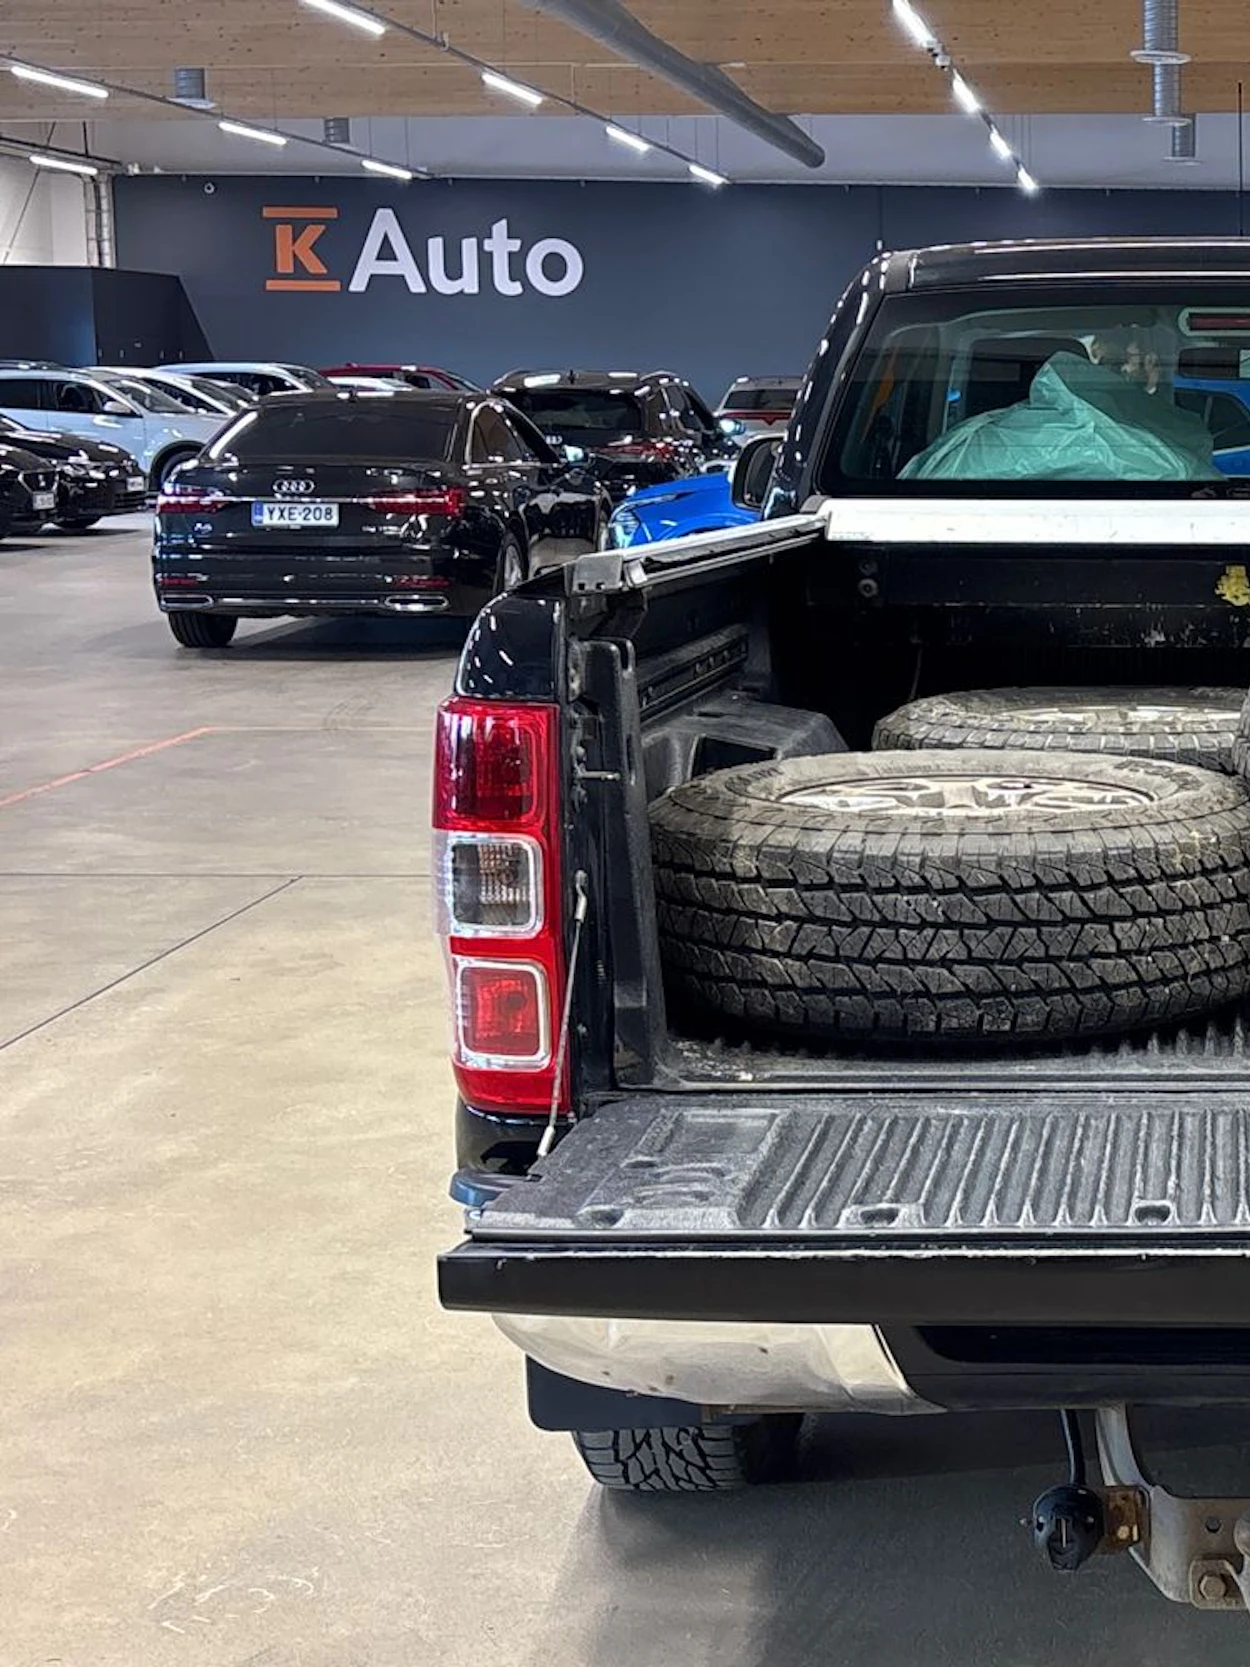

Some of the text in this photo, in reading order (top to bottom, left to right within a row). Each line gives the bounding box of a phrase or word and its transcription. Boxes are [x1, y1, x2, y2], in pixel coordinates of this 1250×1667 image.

[275, 207, 584, 296] K Auto
[267, 506, 333, 521] YXE-208
